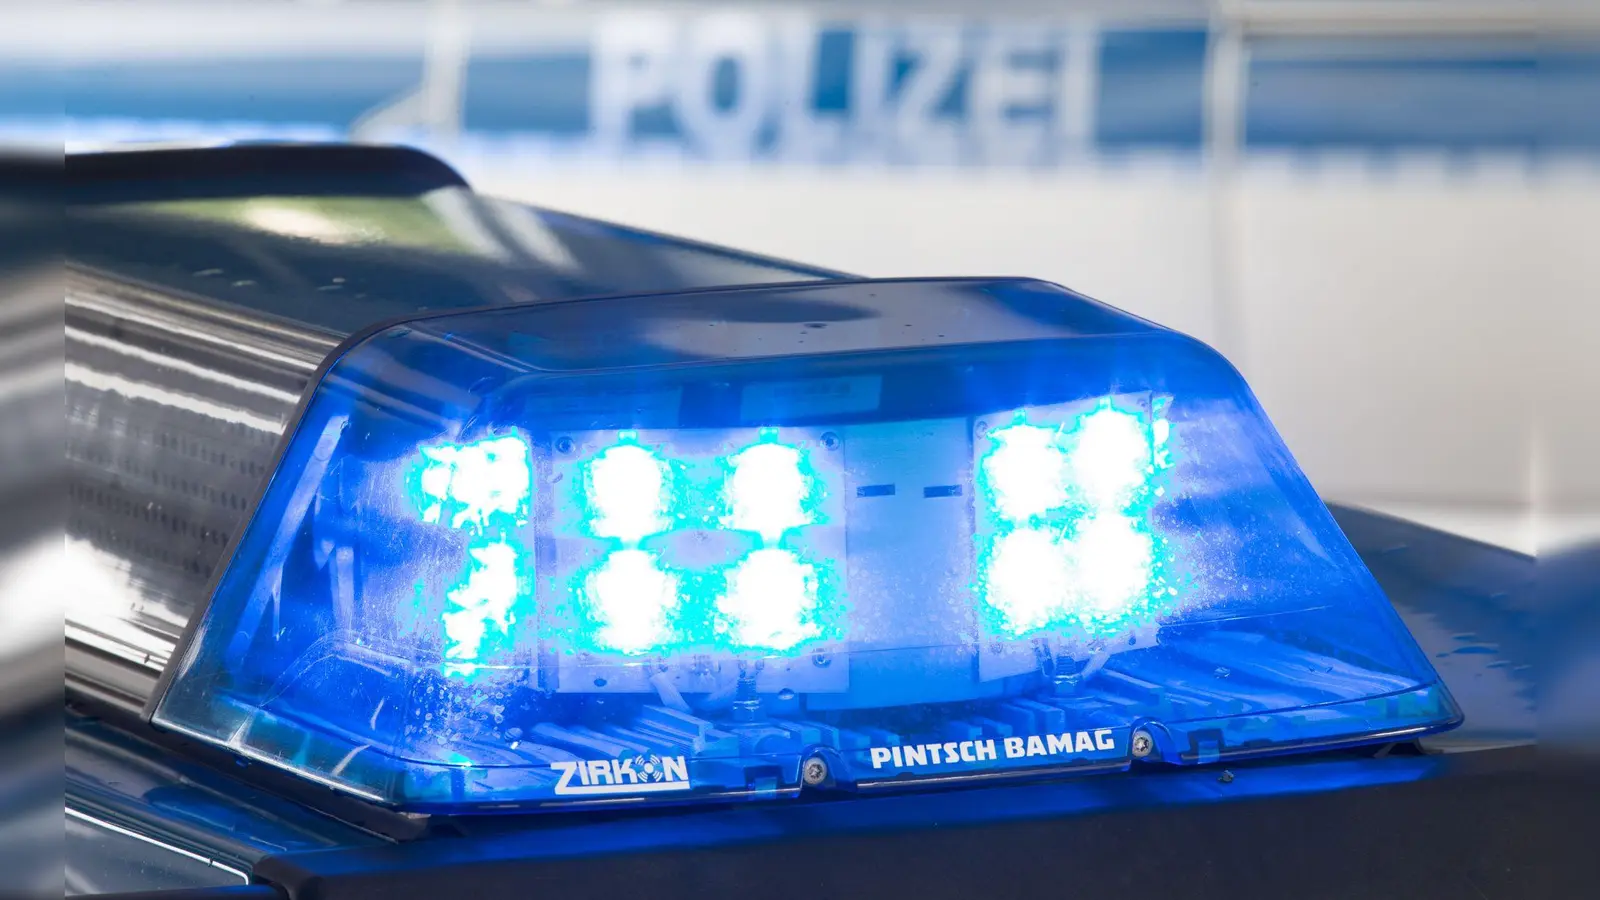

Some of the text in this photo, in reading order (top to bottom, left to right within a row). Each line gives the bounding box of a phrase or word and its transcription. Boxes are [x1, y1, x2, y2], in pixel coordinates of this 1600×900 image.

[591, 17, 1096, 162] POLIZEI
[870, 729, 1115, 769] PINTSCH BAMAG
[551, 754, 691, 795] ZIRKON
